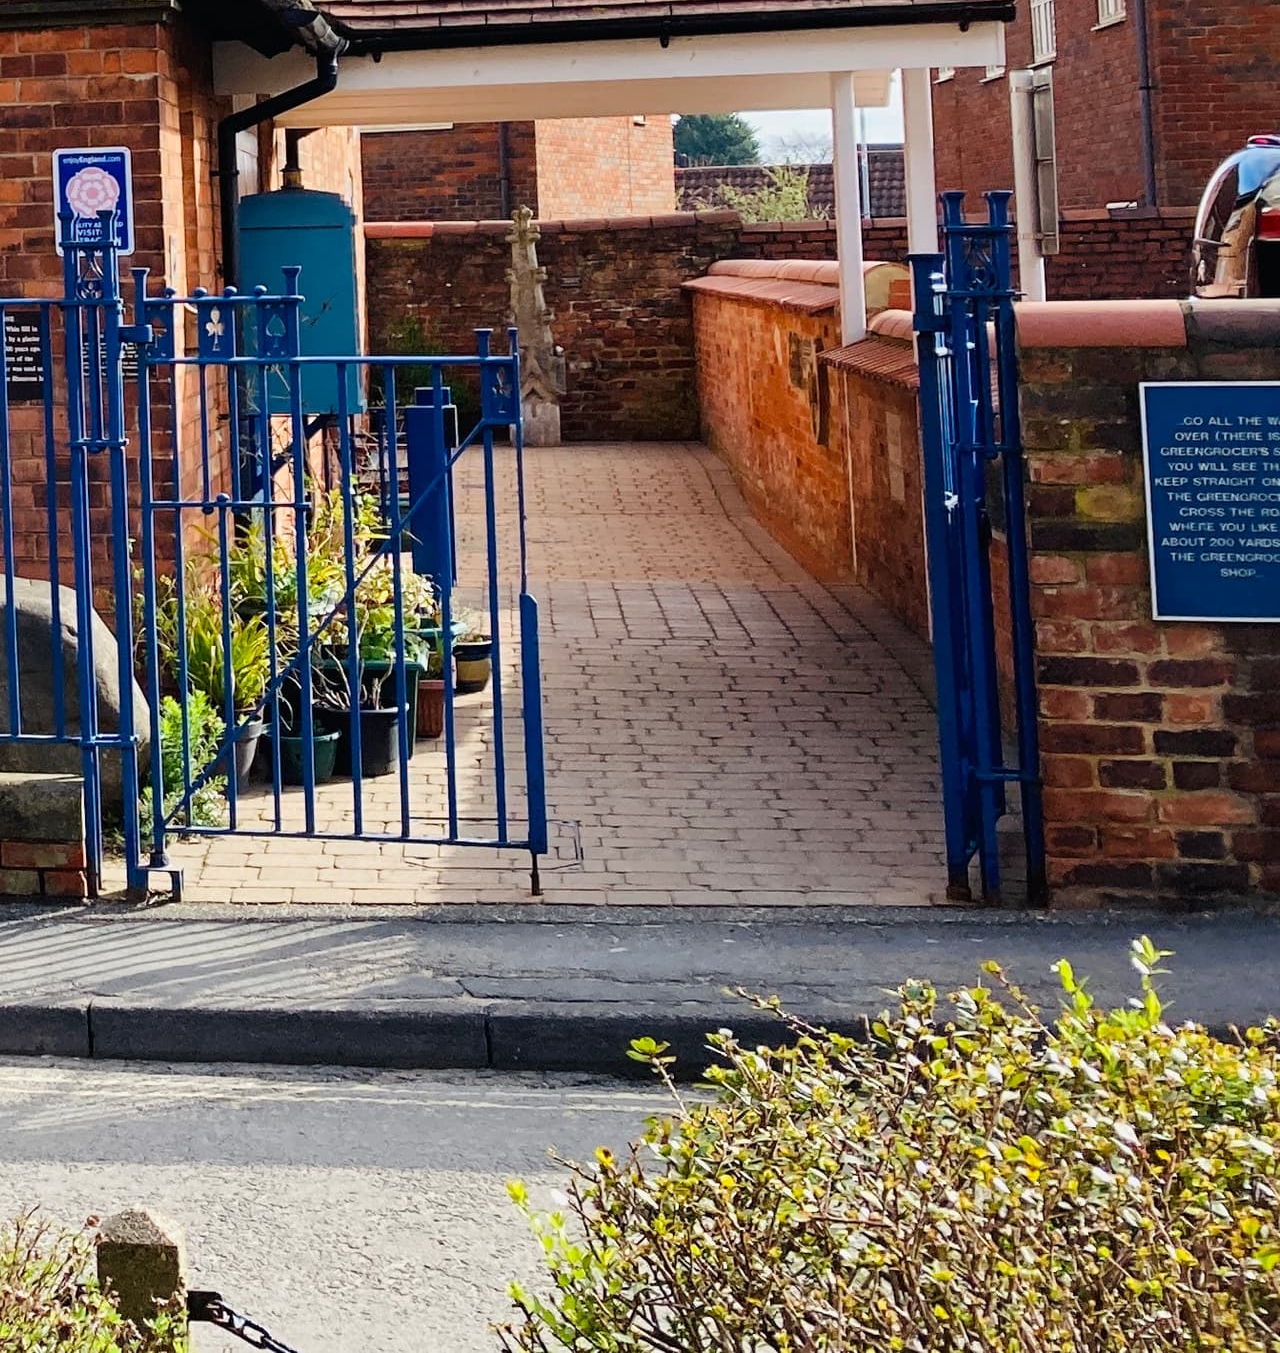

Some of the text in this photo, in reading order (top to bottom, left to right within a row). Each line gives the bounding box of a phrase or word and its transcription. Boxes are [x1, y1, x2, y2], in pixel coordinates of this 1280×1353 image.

[1208, 416, 1233, 426] ALL
[1237, 416, 1263, 426] THE
[1174, 431, 1209, 442] OVER
[1215, 430, 1263, 442] (THERE
[1160, 446, 1270, 457] GREENGROCER'S
[1167, 462, 1194, 472] YOU
[1197, 462, 1229, 472] WILL
[1232, 462, 1257, 472] SEE
[1154, 477, 1189, 487] KEEP
[1192, 477, 1256, 487] STRAIGHT
[1167, 492, 1192, 502] THE
[1179, 507, 1280, 518] CROSS THE RO
[1168, 522, 1279, 533] WHERE YOU LIKE
[1161, 537, 1280, 548] ABOUT 200 YARDS
[1170, 552, 1195, 562] THE
